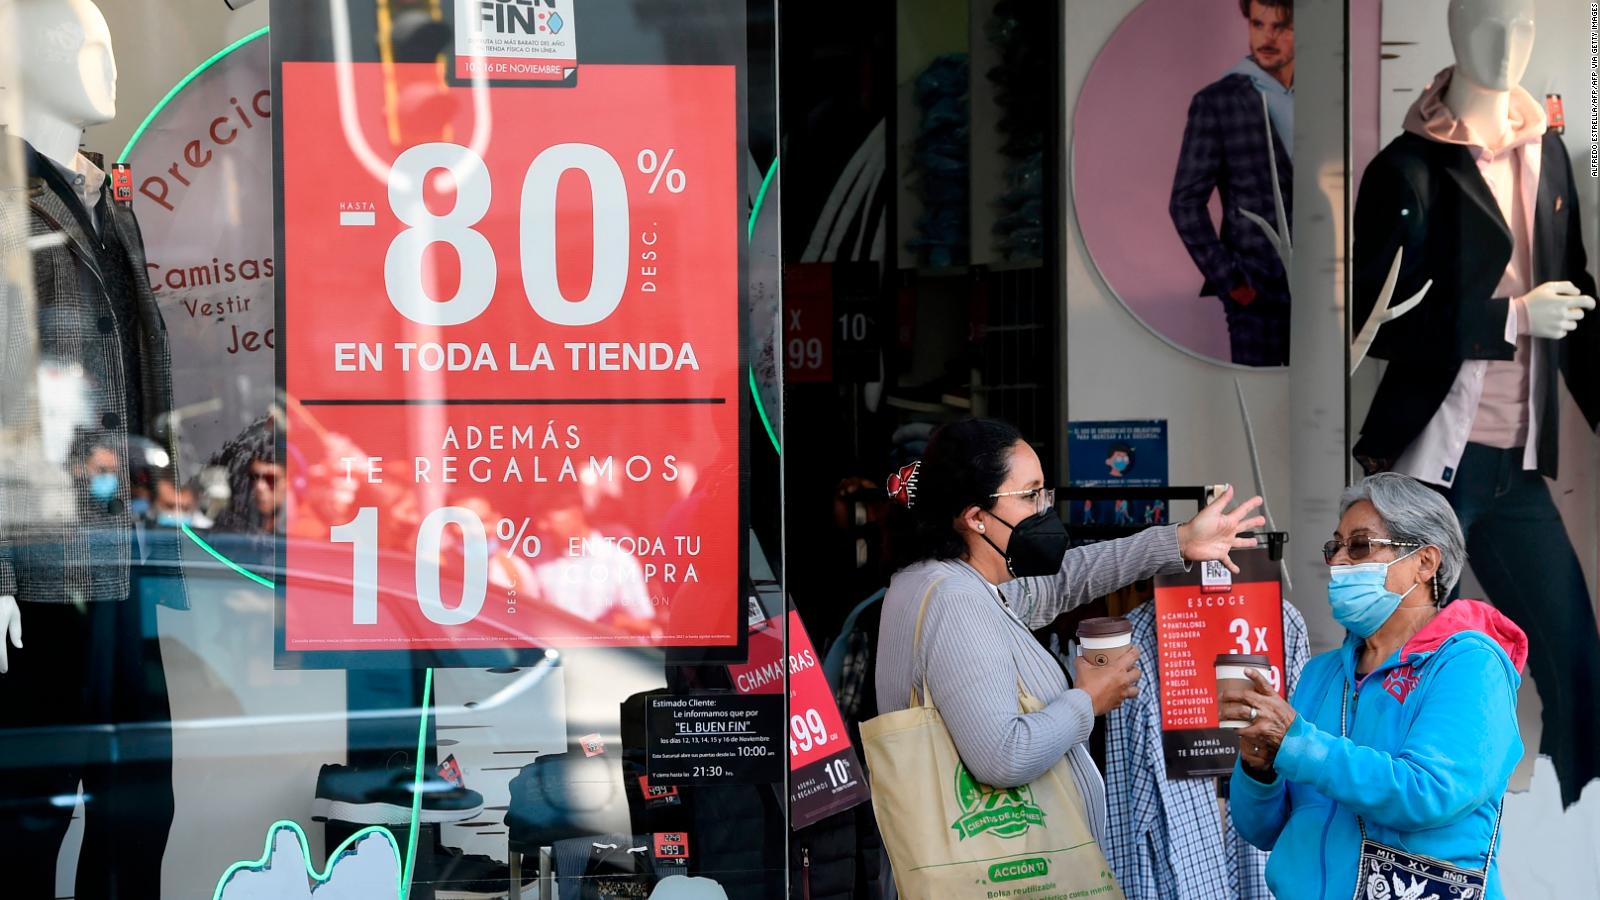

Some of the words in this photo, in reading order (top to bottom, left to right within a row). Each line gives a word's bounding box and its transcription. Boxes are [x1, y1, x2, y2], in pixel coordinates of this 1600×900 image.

[495, 63, 508, 73] DE
[509, 64, 561, 75] NOVIEMBRE
[339, 202, 376, 210] HASTA
[144, 257, 273, 291] Camisas
[183, 296, 251, 318] Vestir
[334, 342, 383, 372] EN
[394, 342, 498, 371] TODA
[509, 342, 554, 371] LA
[564, 342, 700, 371] TIENDA
[442, 420, 581, 450] ADEMÁS
[340, 456, 384, 483] TE
[415, 455, 679, 483] REGALAMOS
[568, 536, 594, 557] EN
[606, 536, 667, 557] TODA
[673, 535, 701, 556] TU
[565, 563, 699, 584] COMPRA
[1188, 596, 1245, 608] ESCOGE
[1168, 631, 1201, 639] SUDADERA
[1229, 618, 1251, 654] 3
[1168, 641, 1188, 649] TENIS
[1169, 651, 1191, 659] JEANS
[1171, 688, 1208, 697] CARTERAS
[652, 700, 687, 708] Estimado
[688, 699, 717, 708] Cliente:
[1172, 697, 1213, 706] CINTURONES
[673, 710, 683, 718] Le
[684, 710, 728, 718] informamos
[729, 710, 744, 719] que
[745, 710, 759, 718] por
[1172, 707, 1206, 715] GUANTES
[1173, 717, 1208, 725] JOGGERS
[695, 722, 726, 732] BUEN
[737, 746, 766, 757] 10:00
[1178, 749, 1187, 757] TE
[1190, 747, 1235, 756] REGALAMOS
[693, 766, 722, 777] 21:30
[998, 812, 1010, 821] DE
[661, 845, 679, 855] 499
[1377, 849, 1396, 862] MIS
[1408, 860, 1430, 872] XV
[994, 862, 1035, 878] ACCIÓN
[1036, 862, 1045, 873] 17
[987, 888, 1011, 899] Bolsa
[1013, 882, 1056, 896] reutilizable
